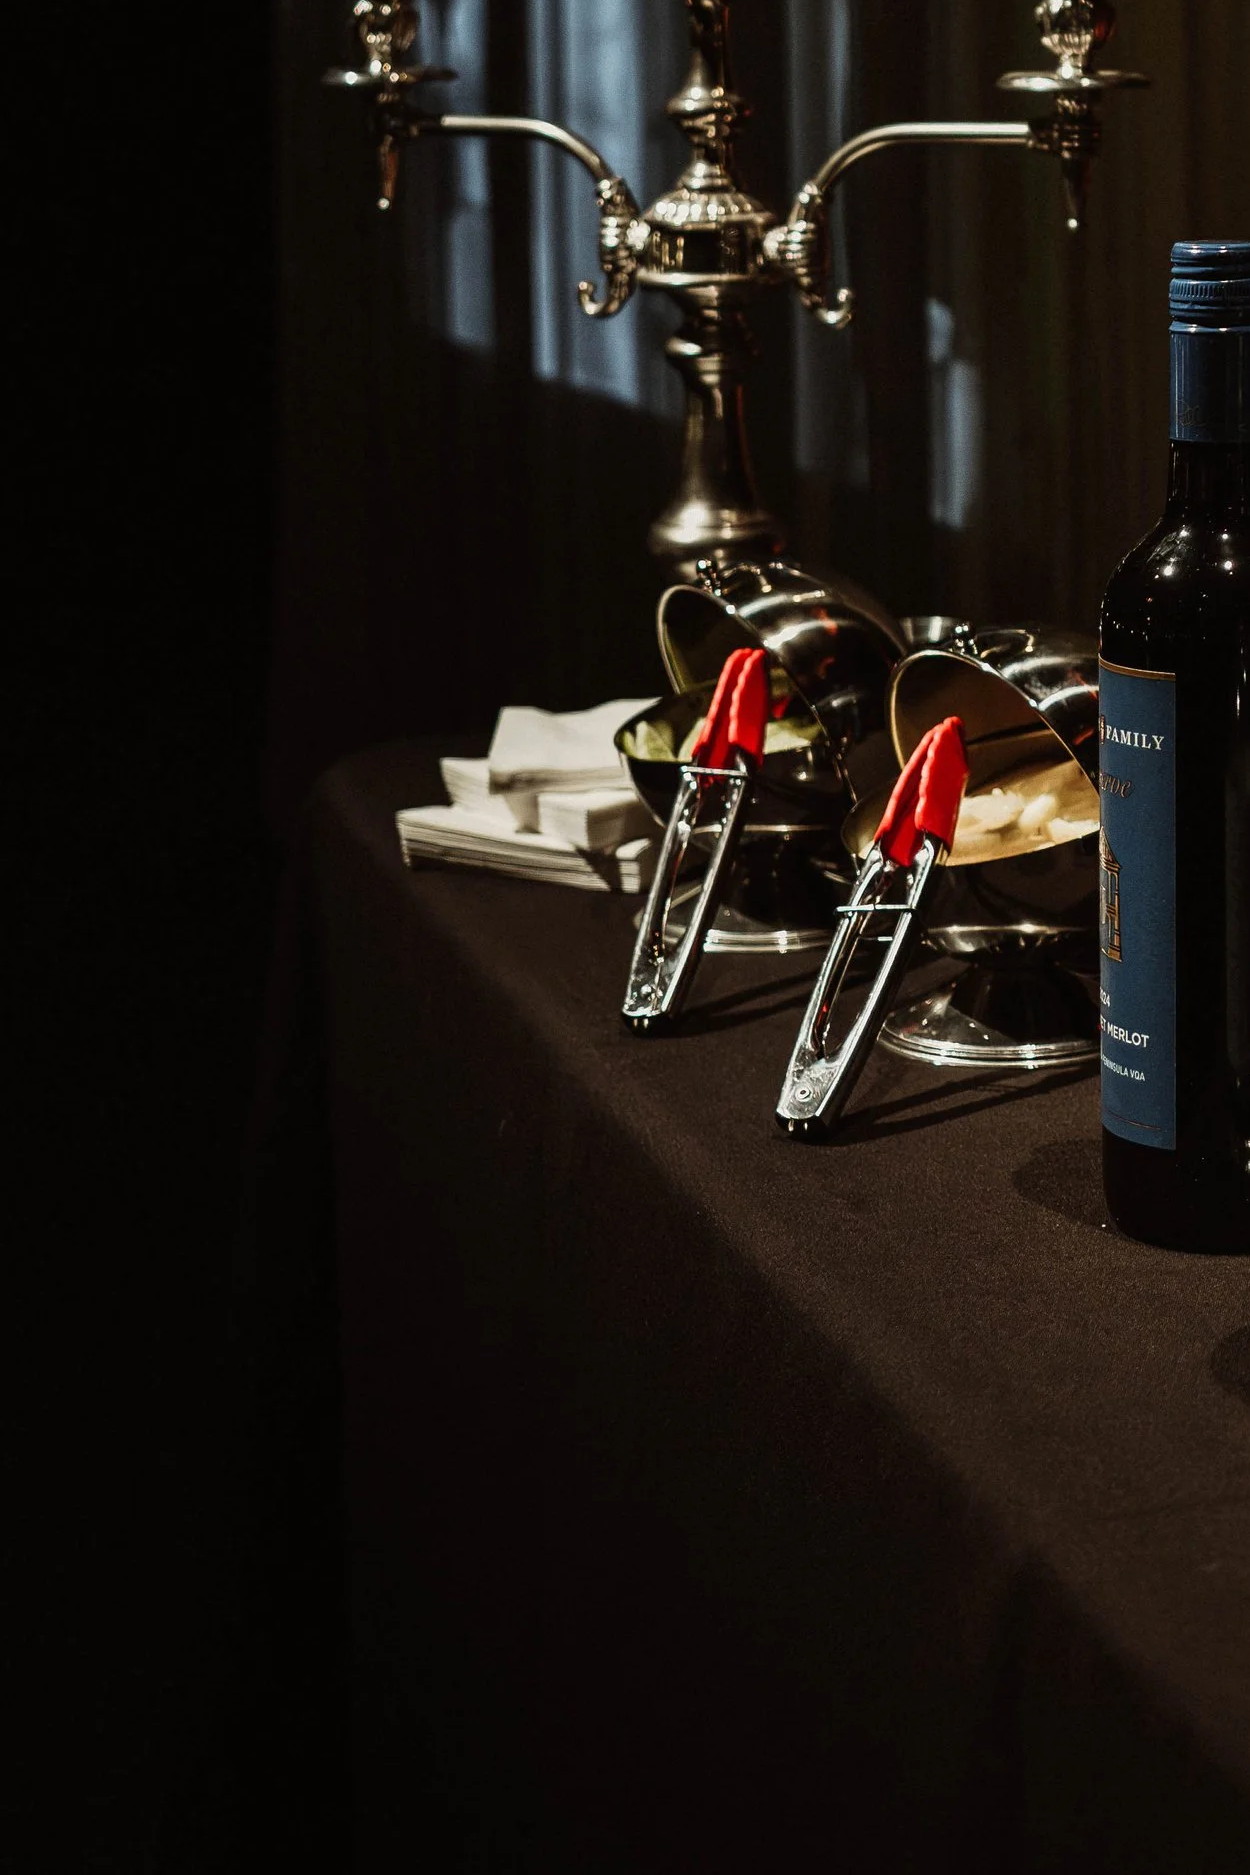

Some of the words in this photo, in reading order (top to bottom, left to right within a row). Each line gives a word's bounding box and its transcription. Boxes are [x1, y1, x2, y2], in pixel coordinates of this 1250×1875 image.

[1106, 725, 1165, 751] FAMILY
[1107, 1022, 1150, 1048] MERLOT
[1129, 1069, 1145, 1082] VQA
